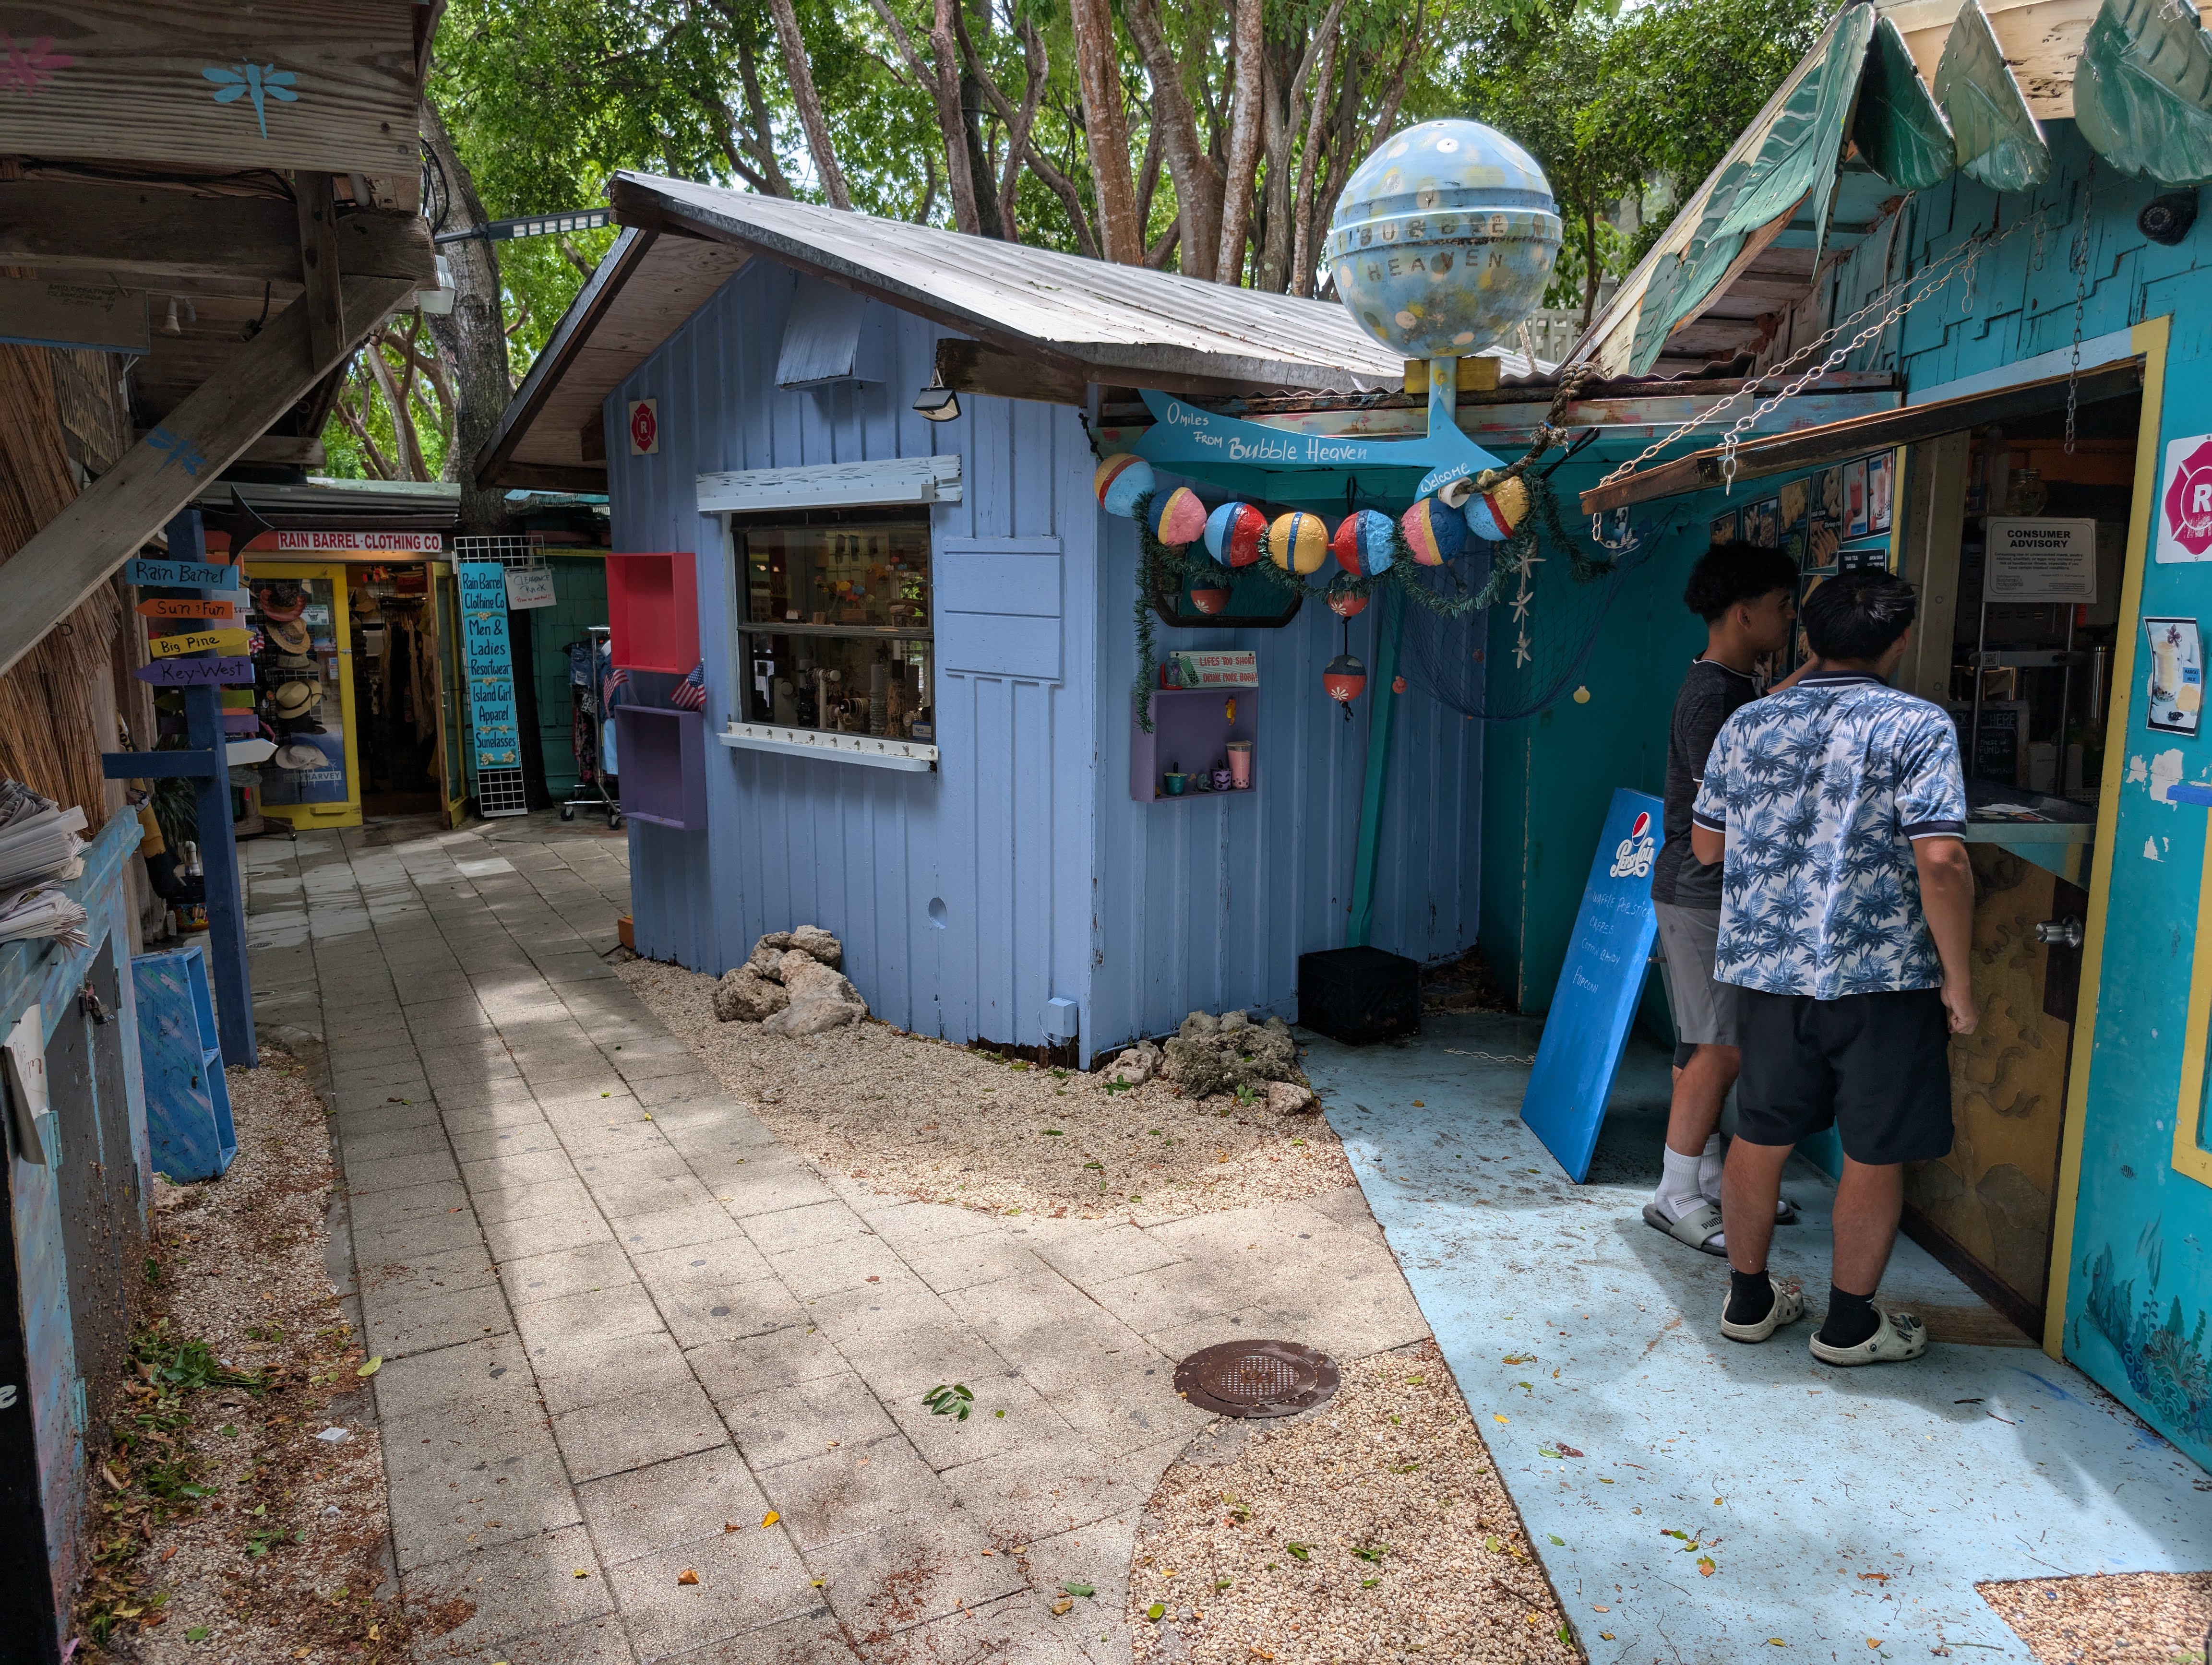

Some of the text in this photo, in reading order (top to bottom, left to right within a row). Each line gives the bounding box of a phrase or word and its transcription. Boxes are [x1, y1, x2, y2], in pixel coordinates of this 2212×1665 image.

[1367, 249, 1503, 281] HEAVEN
[640, 421, 648, 434] R
[1193, 431, 1367, 463] FROM Bubble Heaven
[2192, 484, 2212, 513] R
[280, 532, 309, 547] RAIN
[313, 534, 359, 548] BARREL
[365, 535, 420, 550] CLOTHING
[2007, 530, 2071, 538] CONSUMER
[2010, 540, 2068, 548] ADVISORY
[136, 561, 225, 584] Rain Barrel
[463, 572, 502, 590] Rain Barrel
[514, 574, 550, 585] CLEARANCE
[155, 601, 190, 615] Sun
[203, 602, 225, 616] Fun
[465, 592, 504, 609] Clothing Co
[469, 619, 503, 636] Men &
[160, 636, 220, 653] Big Pine
[470, 639, 506, 656] Ladies
[471, 658, 511, 676] Resortwear
[1199, 656, 1255, 667] LIFES TOO SHORT
[1202, 672, 1258, 683] DRINK MORE BOBA!
[473, 685, 512, 702] Island Girl
[479, 704, 509, 725] Apparel
[1989, 713, 2016, 727] HERE
[476, 731, 516, 749] Sunglasses
[1592, 892, 1616, 909] WAFFLE
[1589, 915, 1614, 935] CREPES
[1581, 938, 1621, 967] COTTON CANDY
[1572, 965, 1599, 994] POPCORN
